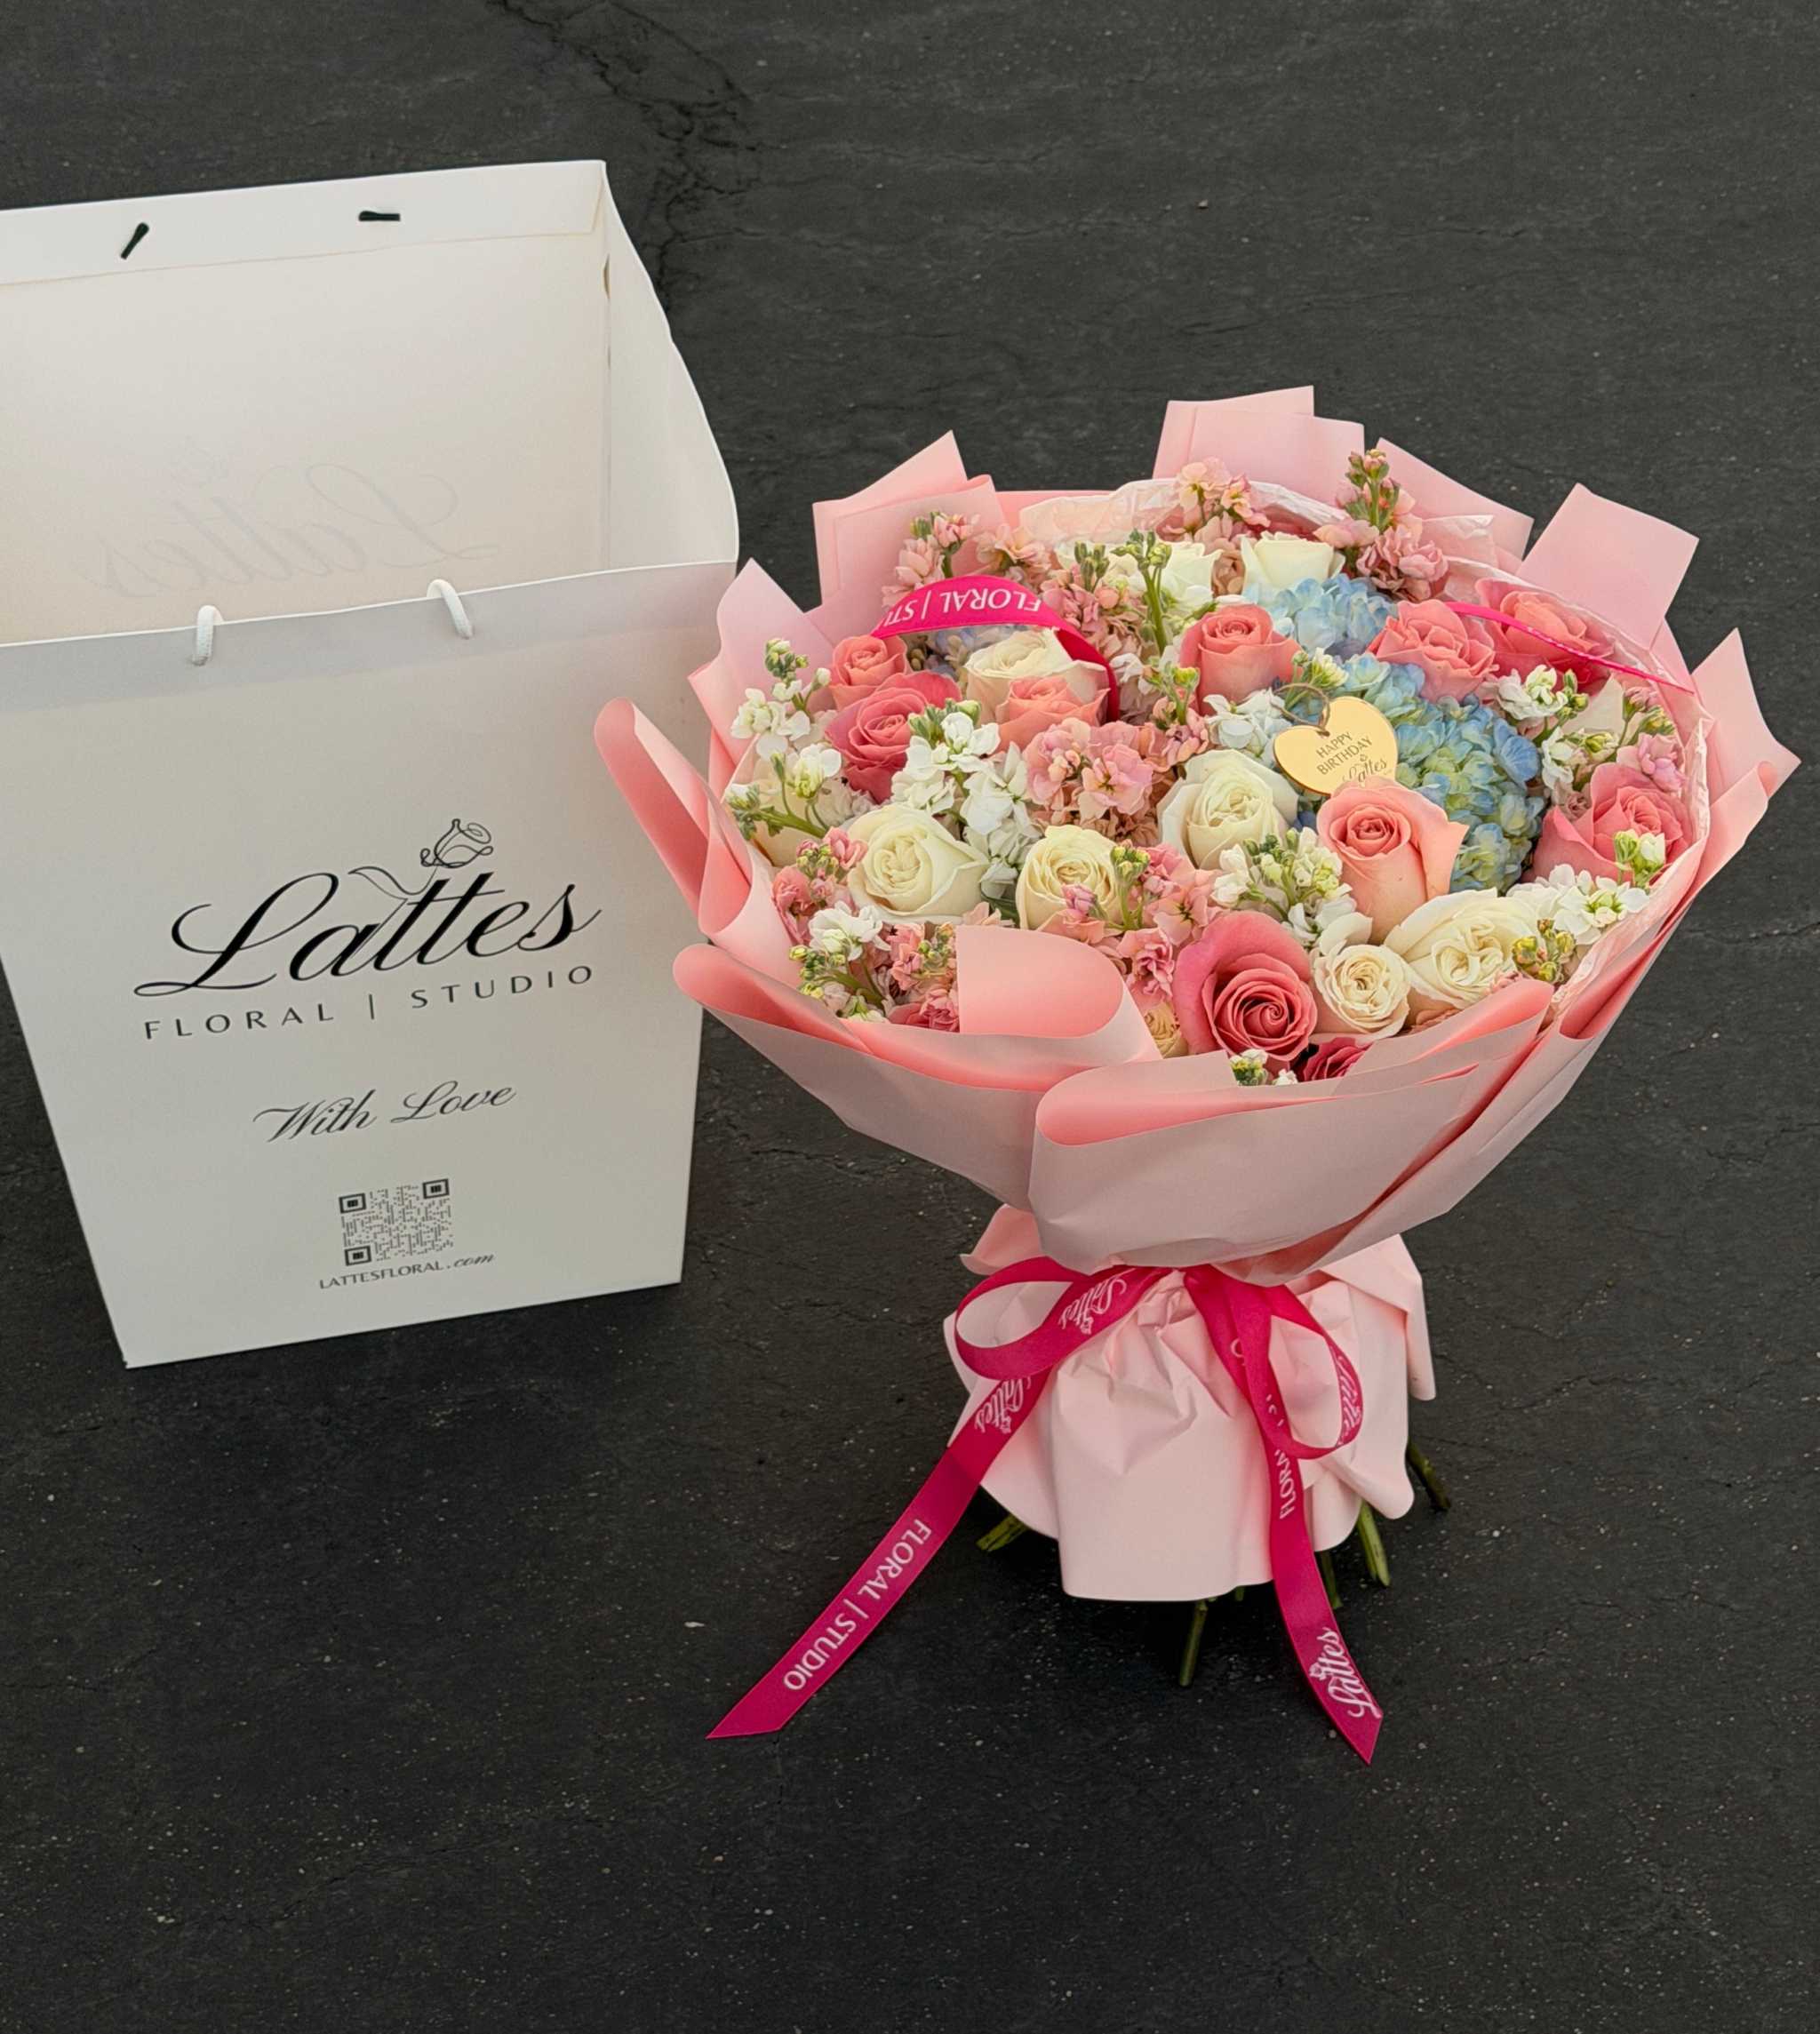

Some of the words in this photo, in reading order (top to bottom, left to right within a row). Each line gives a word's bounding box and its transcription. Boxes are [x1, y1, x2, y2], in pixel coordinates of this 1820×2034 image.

[938, 587, 1042, 613] FLORAL
[1315, 730, 1353, 759] HAPPY
[1316, 735, 1373, 776] BIRTHDAY
[133, 870, 603, 997] Lattes
[144, 1001, 335, 1041] FLORAL
[411, 964, 594, 1009] STUDIO
[252, 1089, 379, 1144] With
[389, 1079, 517, 1125] Love
[319, 1253, 495, 1290] LATTESFLORAL.com
[1273, 1448, 1297, 1520] FLORA
[857, 1518, 932, 1600] FLORAL
[782, 1612, 858, 1691] STUDIO
[1311, 1626, 1383, 1719] Lattes
